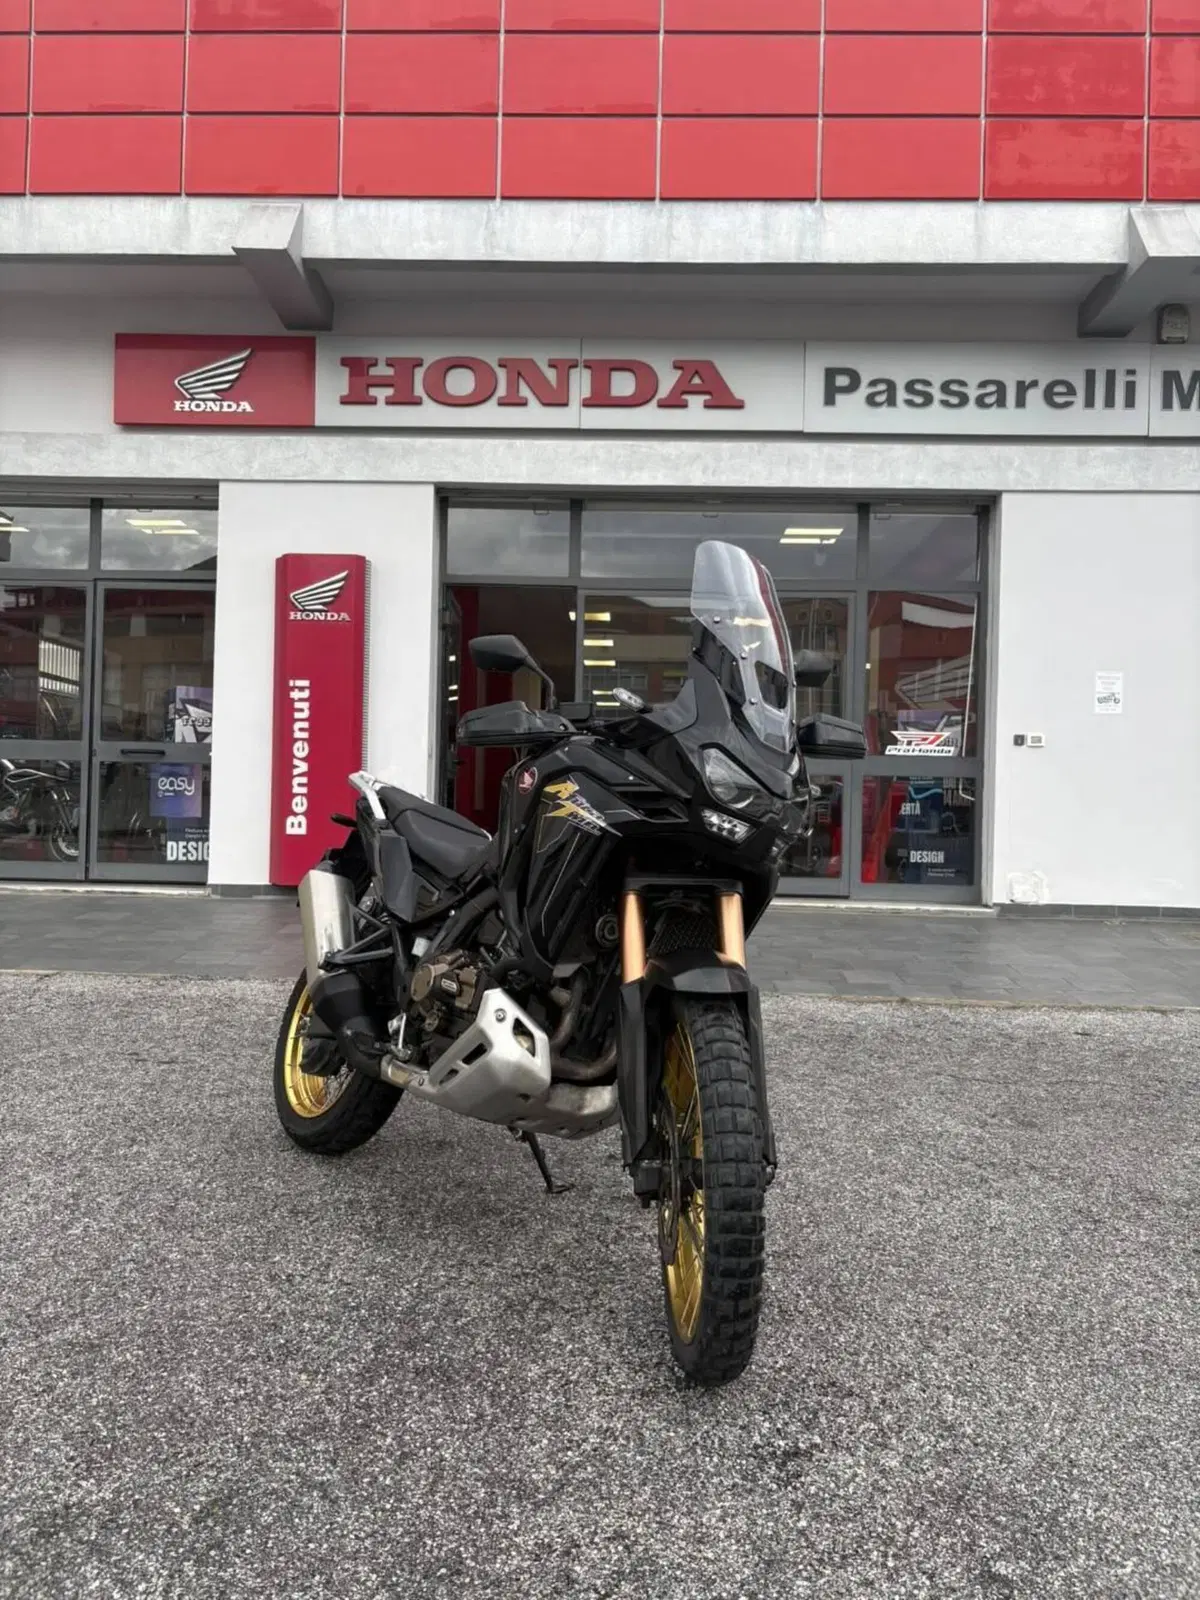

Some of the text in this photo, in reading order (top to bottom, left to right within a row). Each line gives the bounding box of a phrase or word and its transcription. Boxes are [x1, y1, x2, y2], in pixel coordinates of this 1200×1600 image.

[339, 356, 746, 409] HONDA
[823, 366, 1137, 410] Passarelli
[173, 400, 254, 412] HONDA
[289, 611, 352, 621] HONDA
[285, 679, 311, 835] Benvenuti
[157, 776, 196, 796] easy
[909, 850, 945, 863] DESIGN
